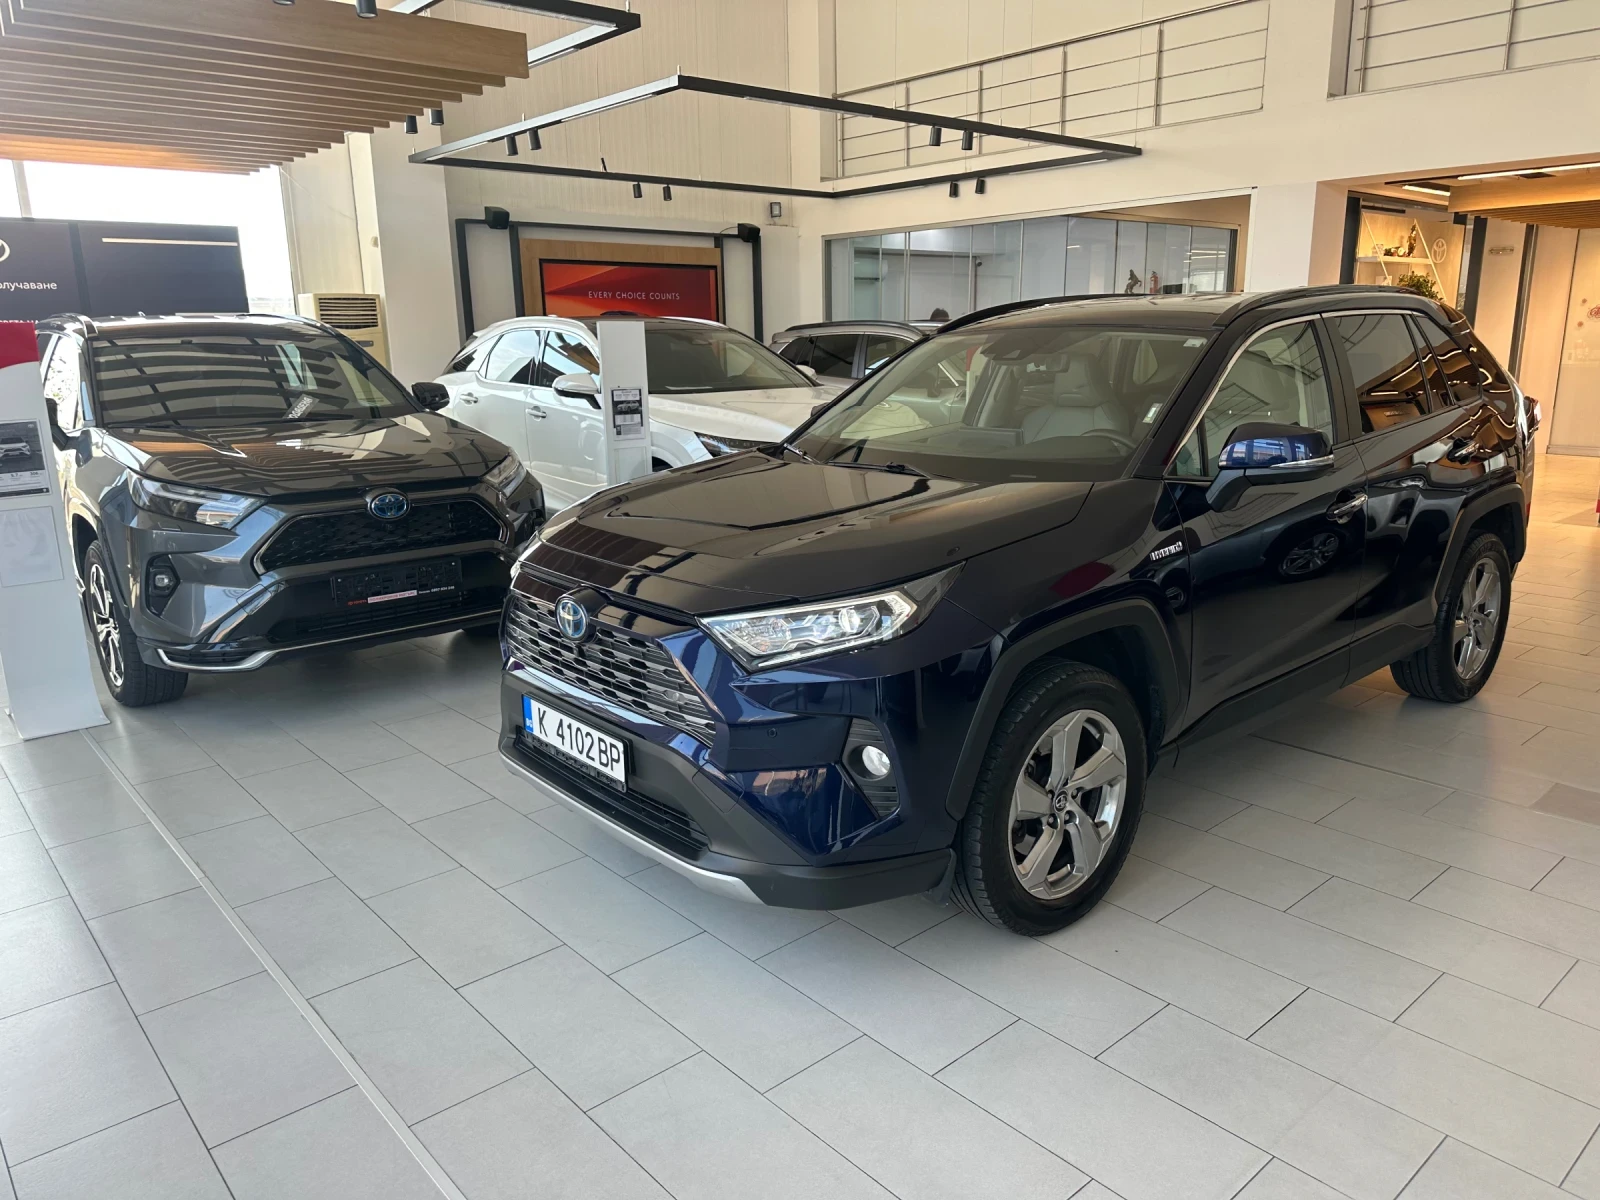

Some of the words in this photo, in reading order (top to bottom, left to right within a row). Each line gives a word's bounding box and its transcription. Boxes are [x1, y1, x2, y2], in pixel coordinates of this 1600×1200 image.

[588, 290, 613, 299] EVERY
[615, 291, 646, 299] CHOICE
[649, 292, 680, 300] COUNTS
[538, 707, 549, 738] K
